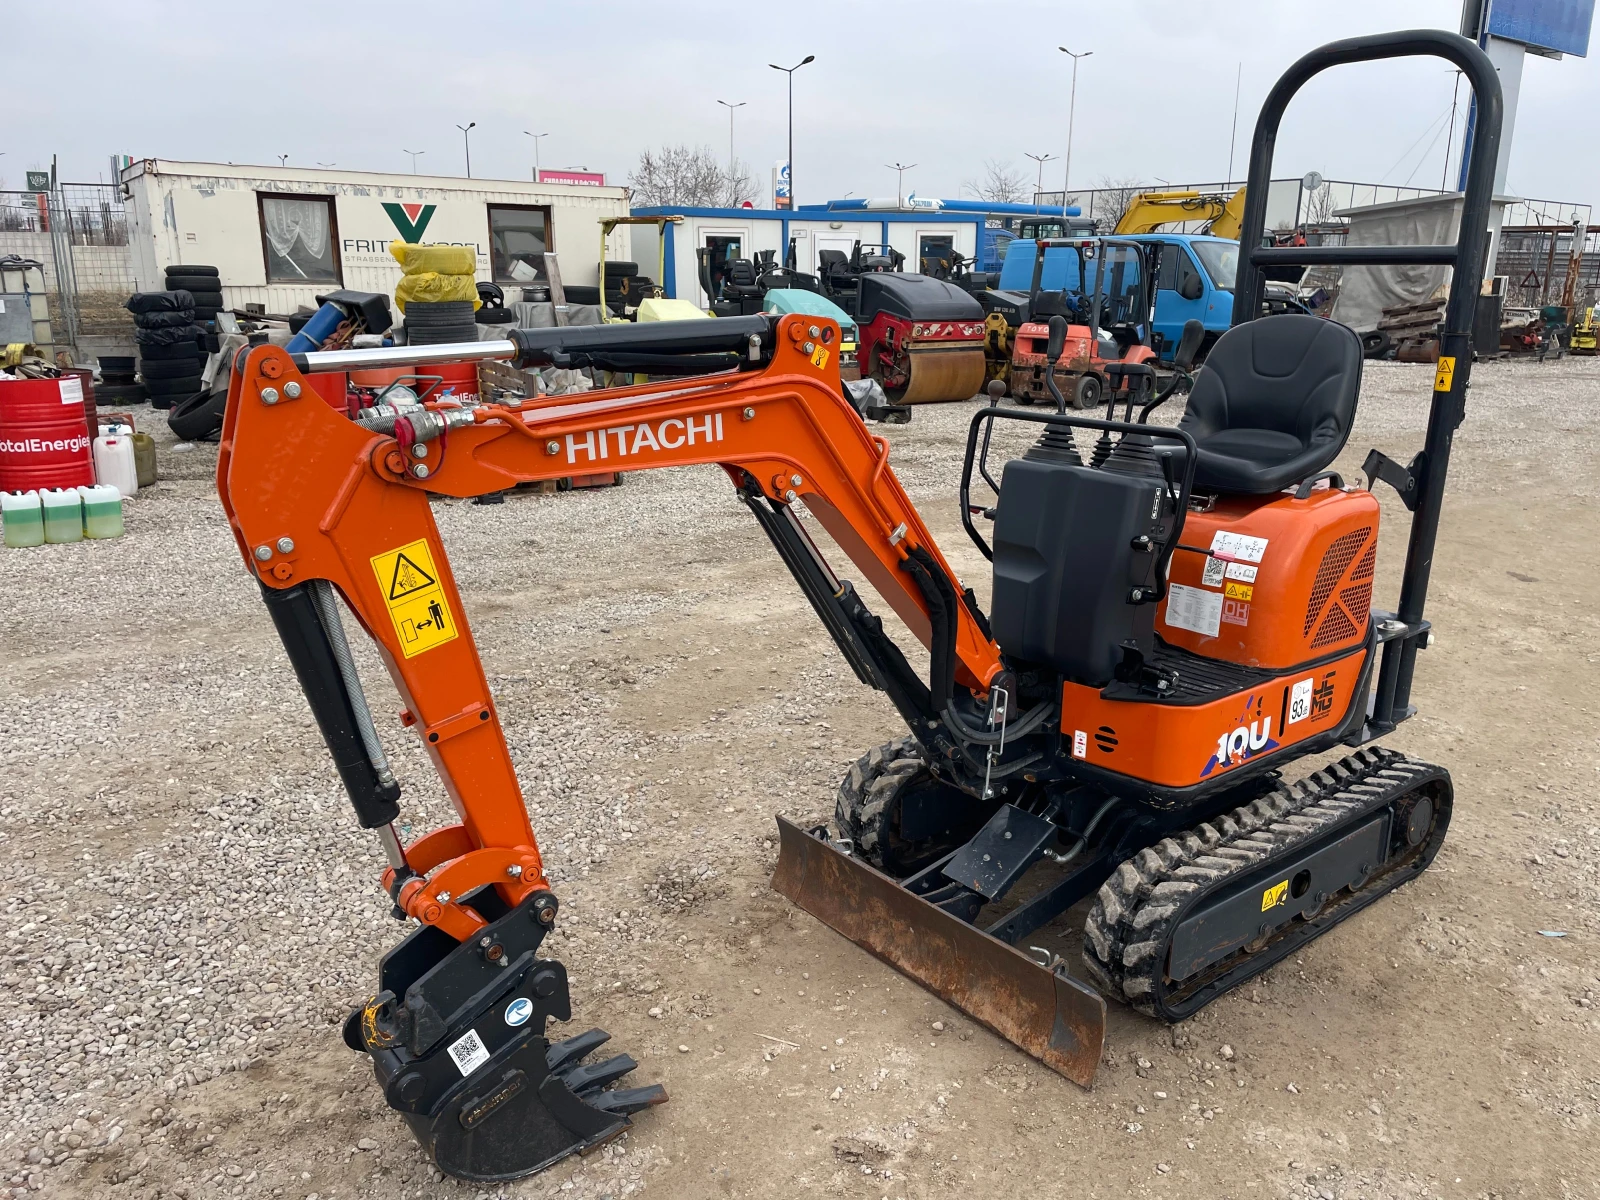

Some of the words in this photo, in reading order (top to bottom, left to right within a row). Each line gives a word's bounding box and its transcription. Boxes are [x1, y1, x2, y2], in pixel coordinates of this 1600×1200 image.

[343, 239, 395, 253] FRIT
[1027, 325, 1049, 333] TOYO
[0, 435, 90, 453] otalEnergies
[565, 413, 724, 464] HITACHI
[1291, 698, 1304, 720] 93
[1216, 715, 1272, 767] 10U
